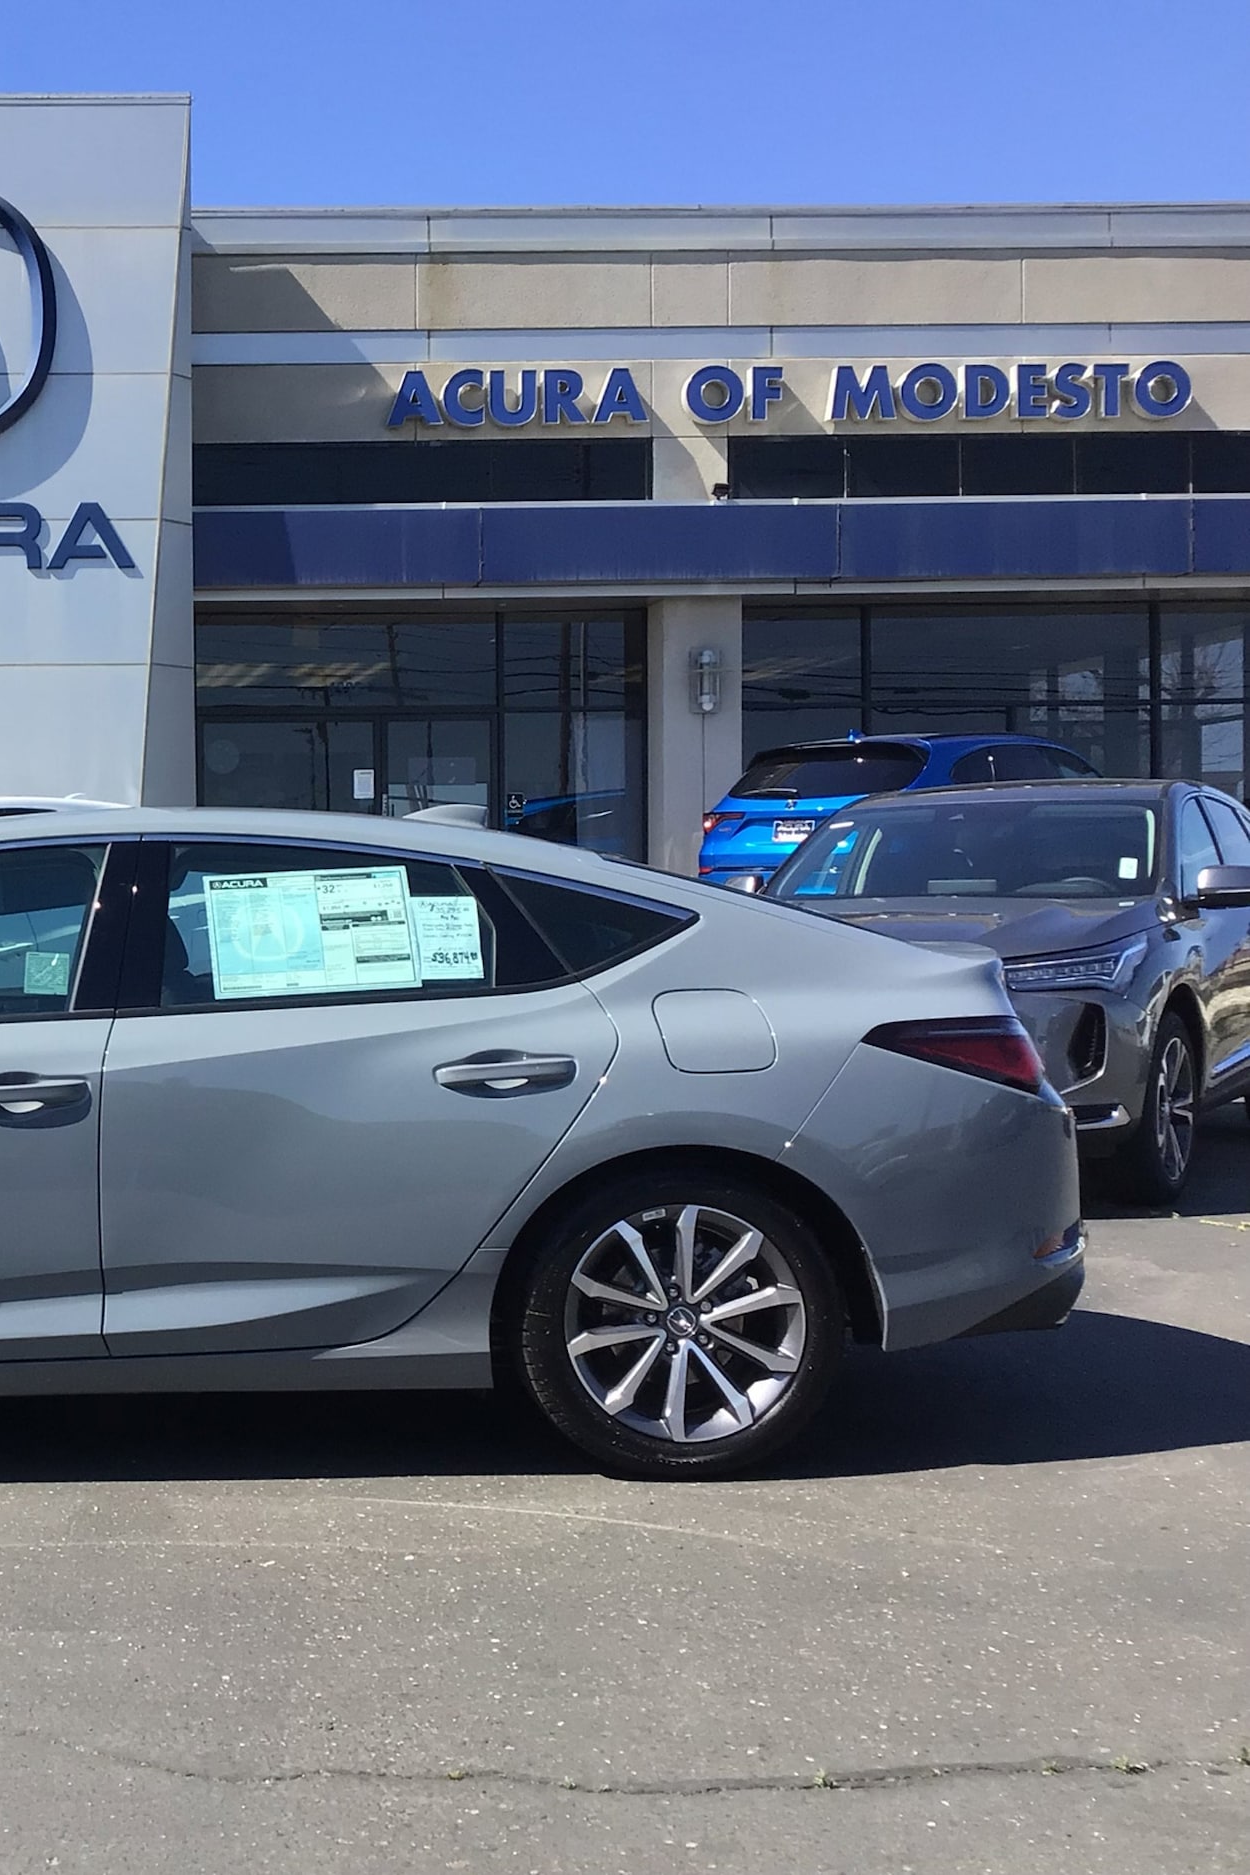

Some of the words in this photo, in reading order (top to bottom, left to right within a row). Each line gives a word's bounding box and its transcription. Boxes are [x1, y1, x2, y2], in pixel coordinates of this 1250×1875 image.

[386, 368, 650, 427] ACURA
[686, 365, 783, 425] OF
[831, 360, 1193, 423] MODESTO
[222, 879, 263, 889] ACURA
[322, 884, 335, 894] 32
